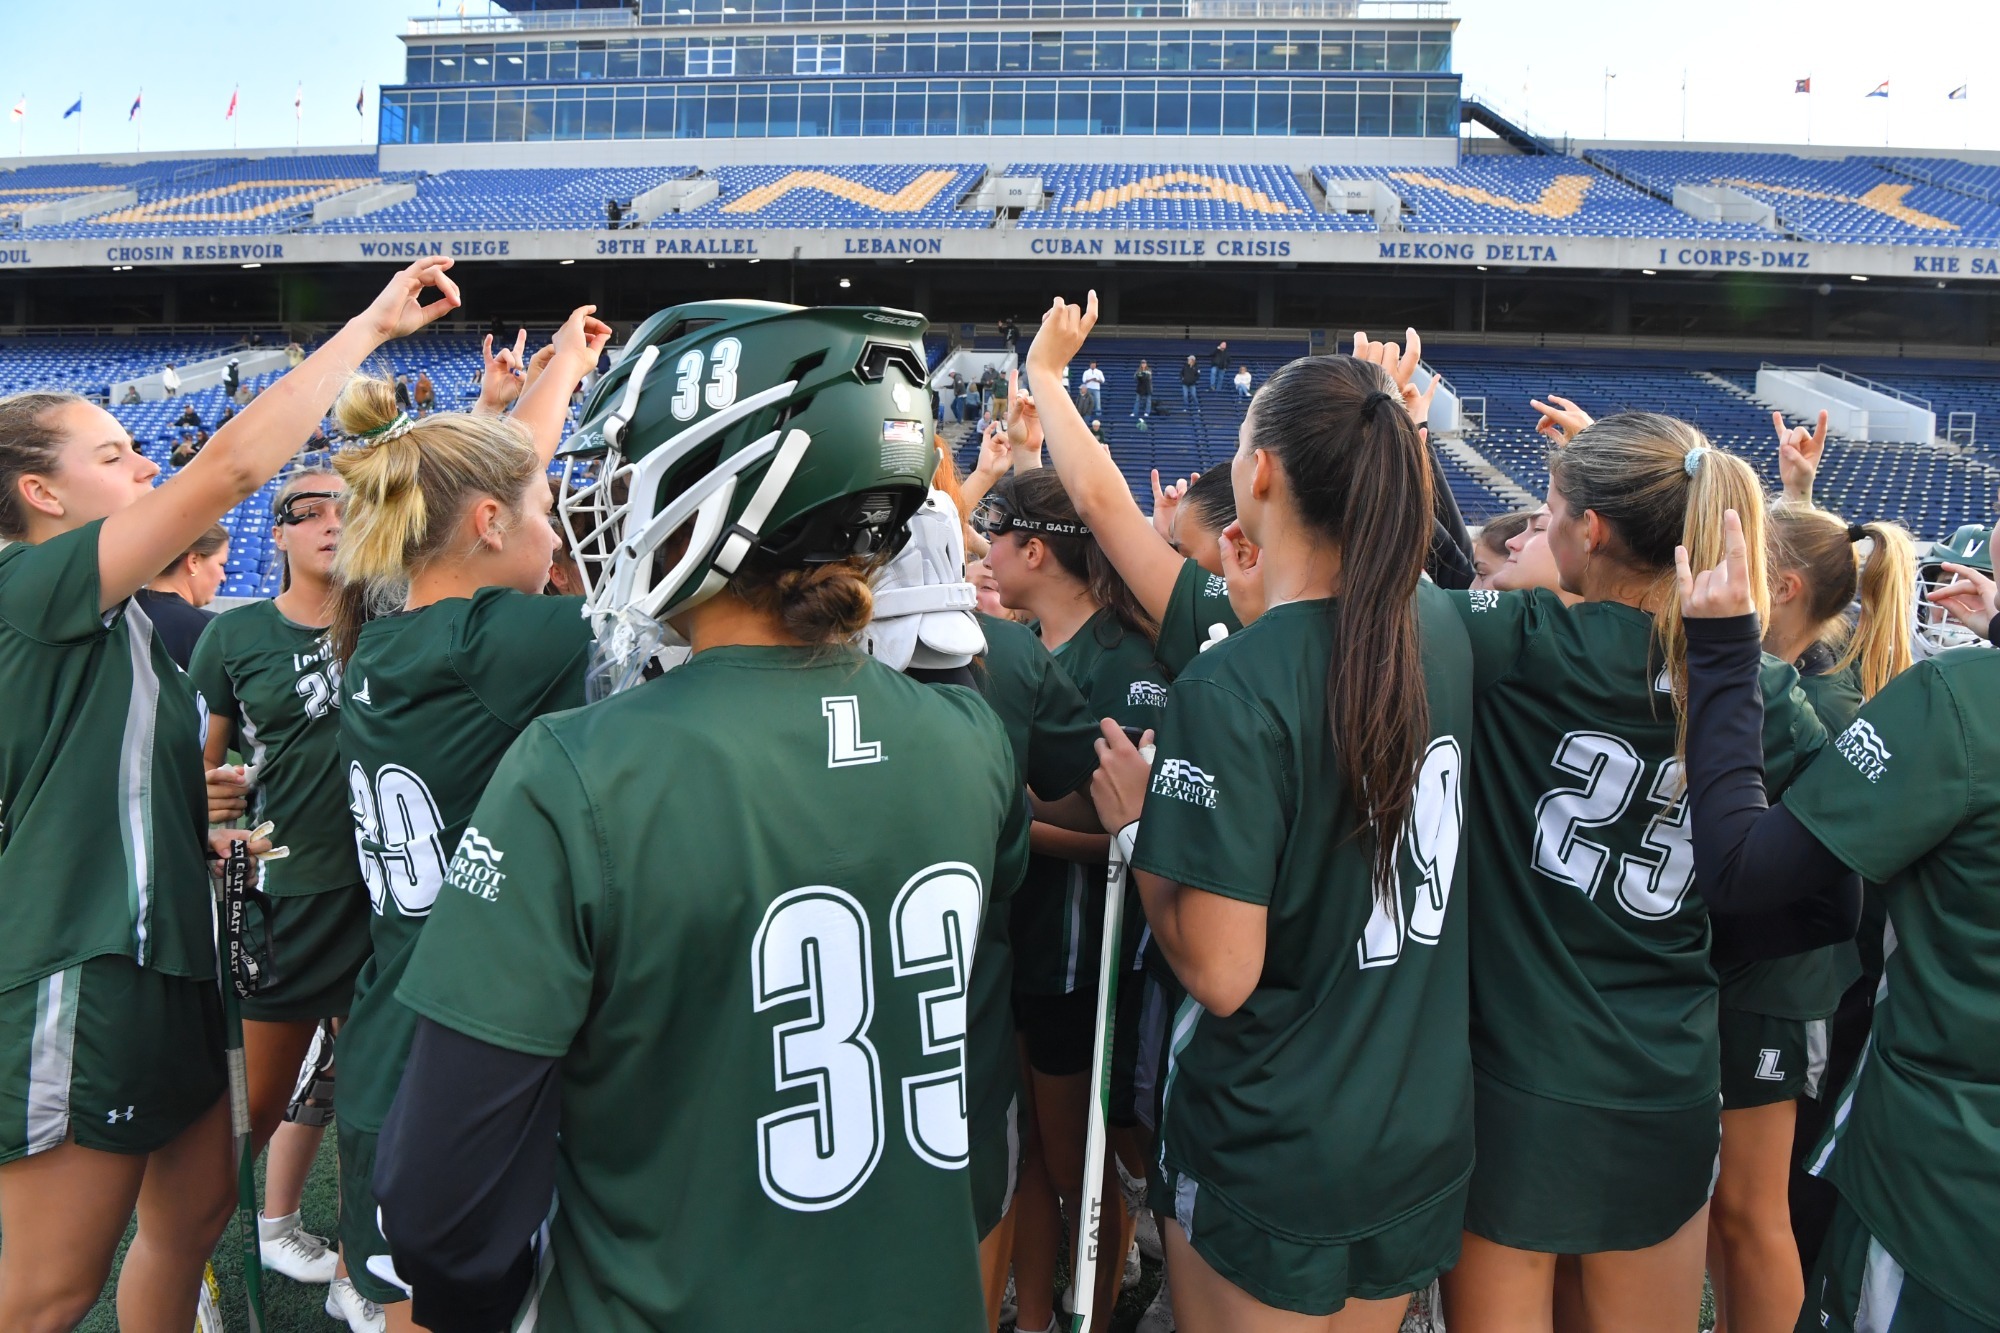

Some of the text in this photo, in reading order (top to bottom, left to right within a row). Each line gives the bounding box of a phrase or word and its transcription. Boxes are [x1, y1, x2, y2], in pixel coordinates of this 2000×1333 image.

[107, 244, 284, 262] CHOSIN RESERVOIR
[360, 241, 510, 257] WONSAN SIEGE
[597, 239, 758, 254] 38TH PARALLEL
[845, 238, 942, 254] LEBANON
[1031, 238, 1291, 257] CUBAN MISSILE CRISIS
[1379, 242, 1558, 262] MEKONG DELTA
[1660, 248, 1811, 268] I CORPS-DMZ
[1914, 255, 1999, 274] KHE SA
[671, 336, 742, 421] 33
[1012, 518, 1042, 529] GAIT
[1046, 523, 1076, 533] GAIT
[821, 695, 882, 768] L
[1840, 728, 1887, 775] PATRIOT
[1151, 783, 1217, 809] LEAGUE
[1153, 773, 1220, 799] PATRIOT
[1531, 730, 1697, 921] 23
[234, 839, 245, 858] AIT
[233, 862, 245, 894] GAIT
[231, 901, 242, 934] GAIT
[230, 941, 239, 974] GAIT
[751, 861, 983, 1212] 33
[1753, 1048, 1785, 1081] L
[241, 1209, 257, 1257] GAIT
[1087, 1197, 1102, 1262] GAIT
